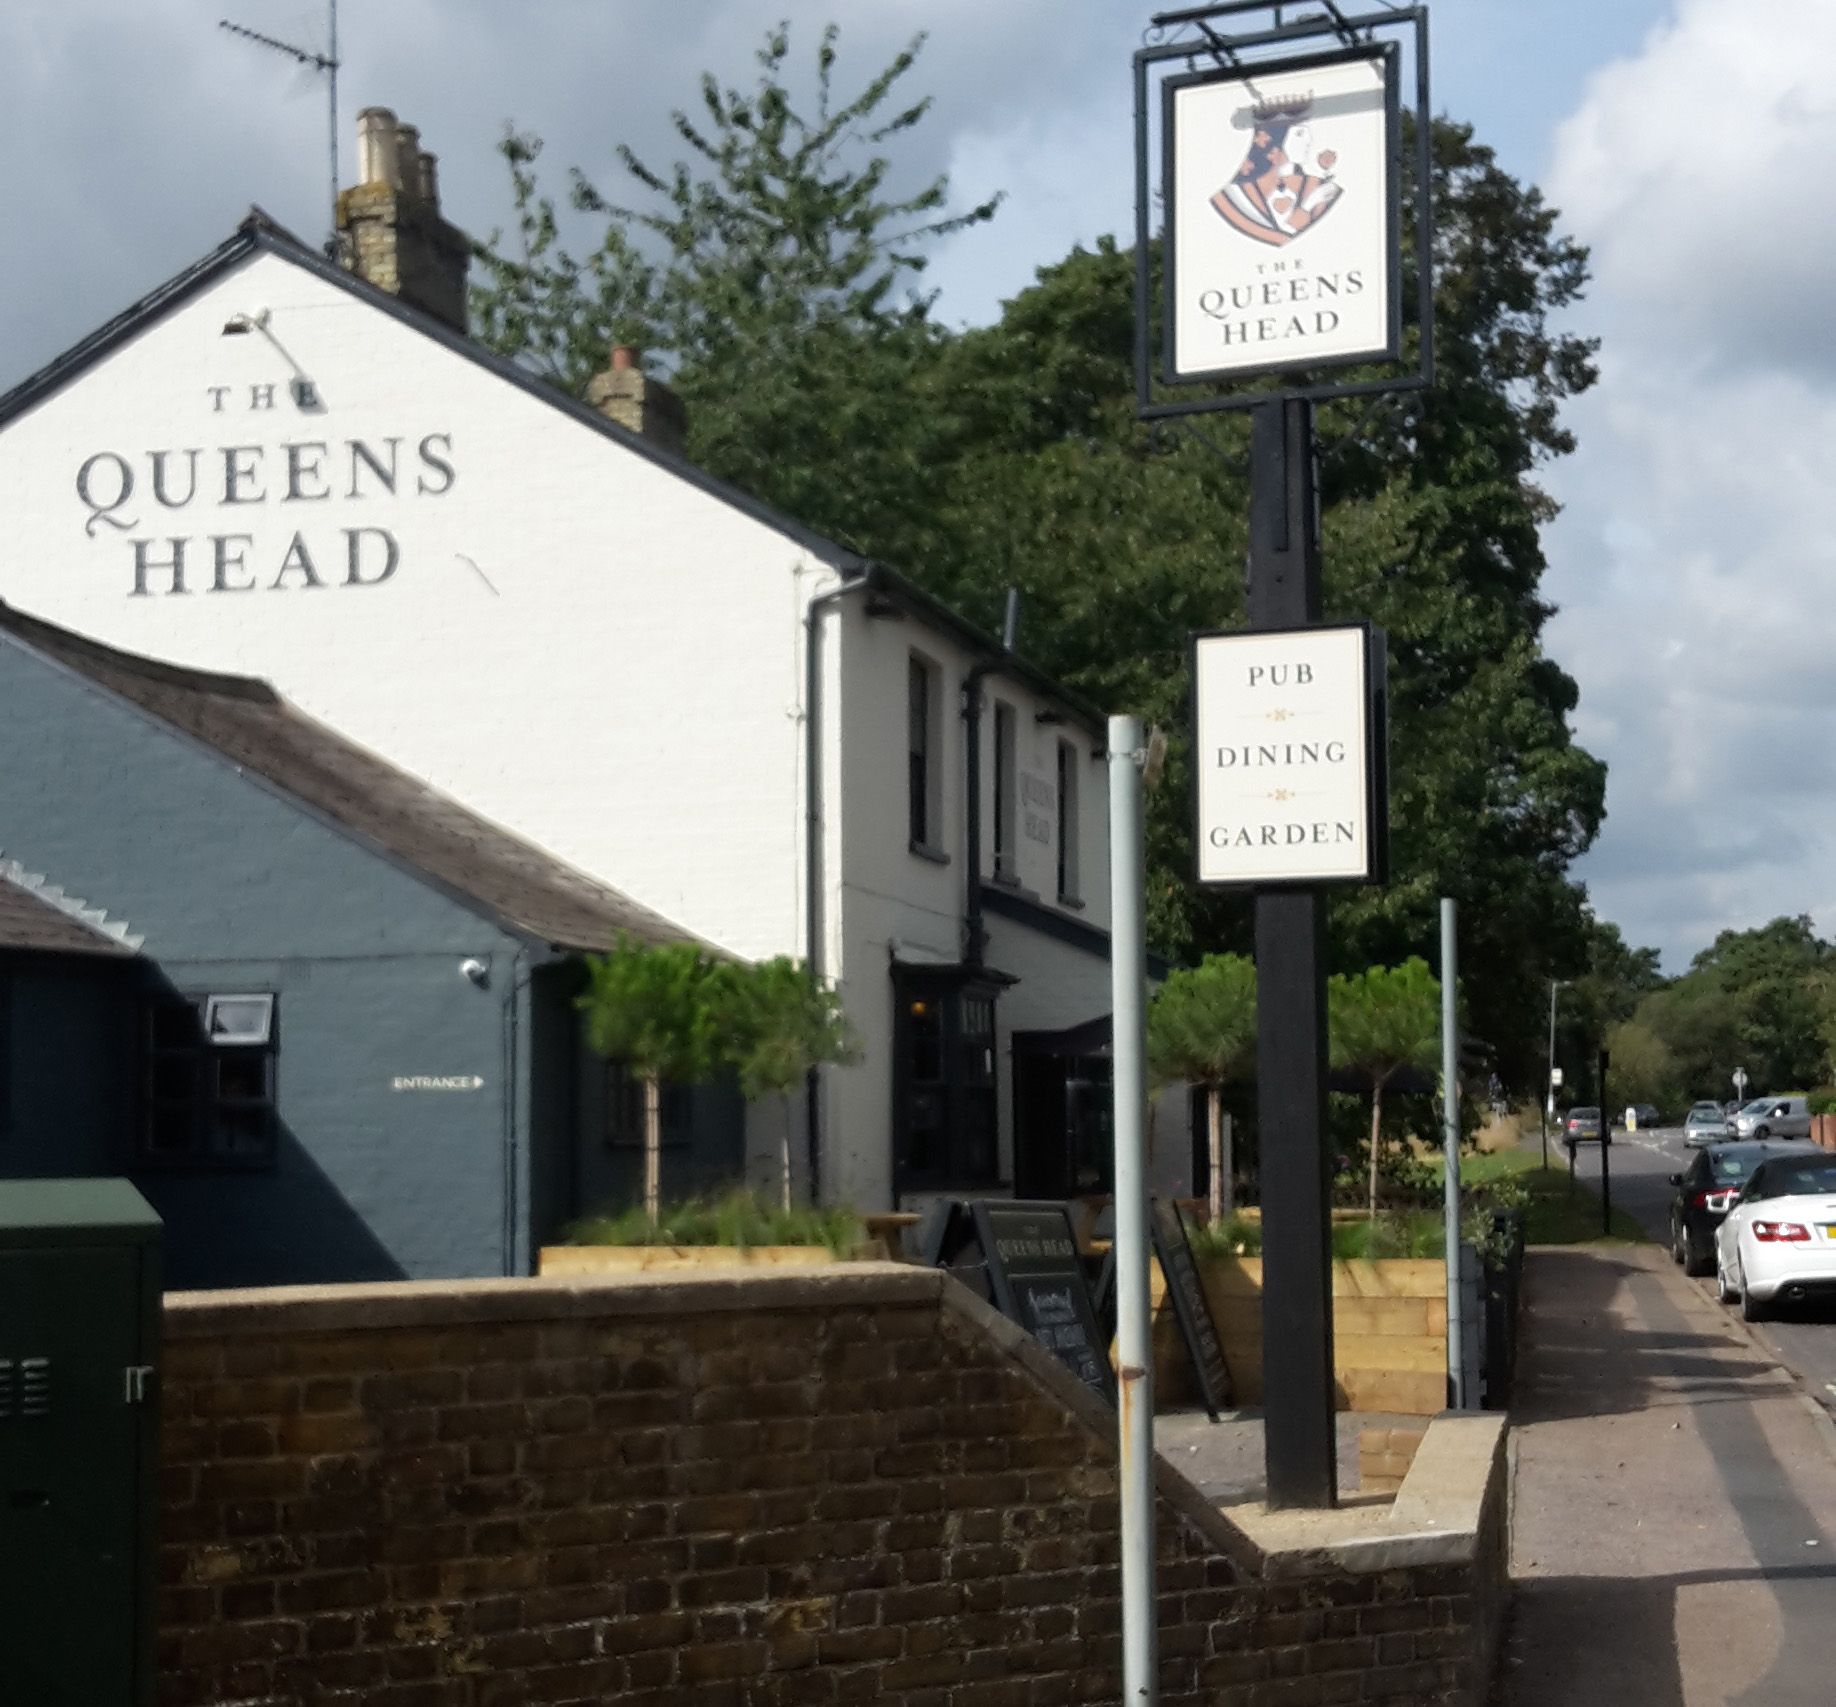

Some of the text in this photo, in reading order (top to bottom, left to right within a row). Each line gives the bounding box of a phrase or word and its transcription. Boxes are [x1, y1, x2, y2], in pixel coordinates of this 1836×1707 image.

[1257, 259, 1303, 275] THE
[1199, 270, 1364, 320] QUEENS
[1222, 310, 1340, 346] HEAD
[207, 382, 318, 412] THE
[76, 433, 457, 537] QUEENS
[127, 526, 400, 597] HEAD
[1248, 663, 1314, 687] PUB
[1217, 742, 1346, 768] DINING
[1210, 822, 1355, 848] GARDEN
[393, 1076, 471, 1090] ENTRANCE
